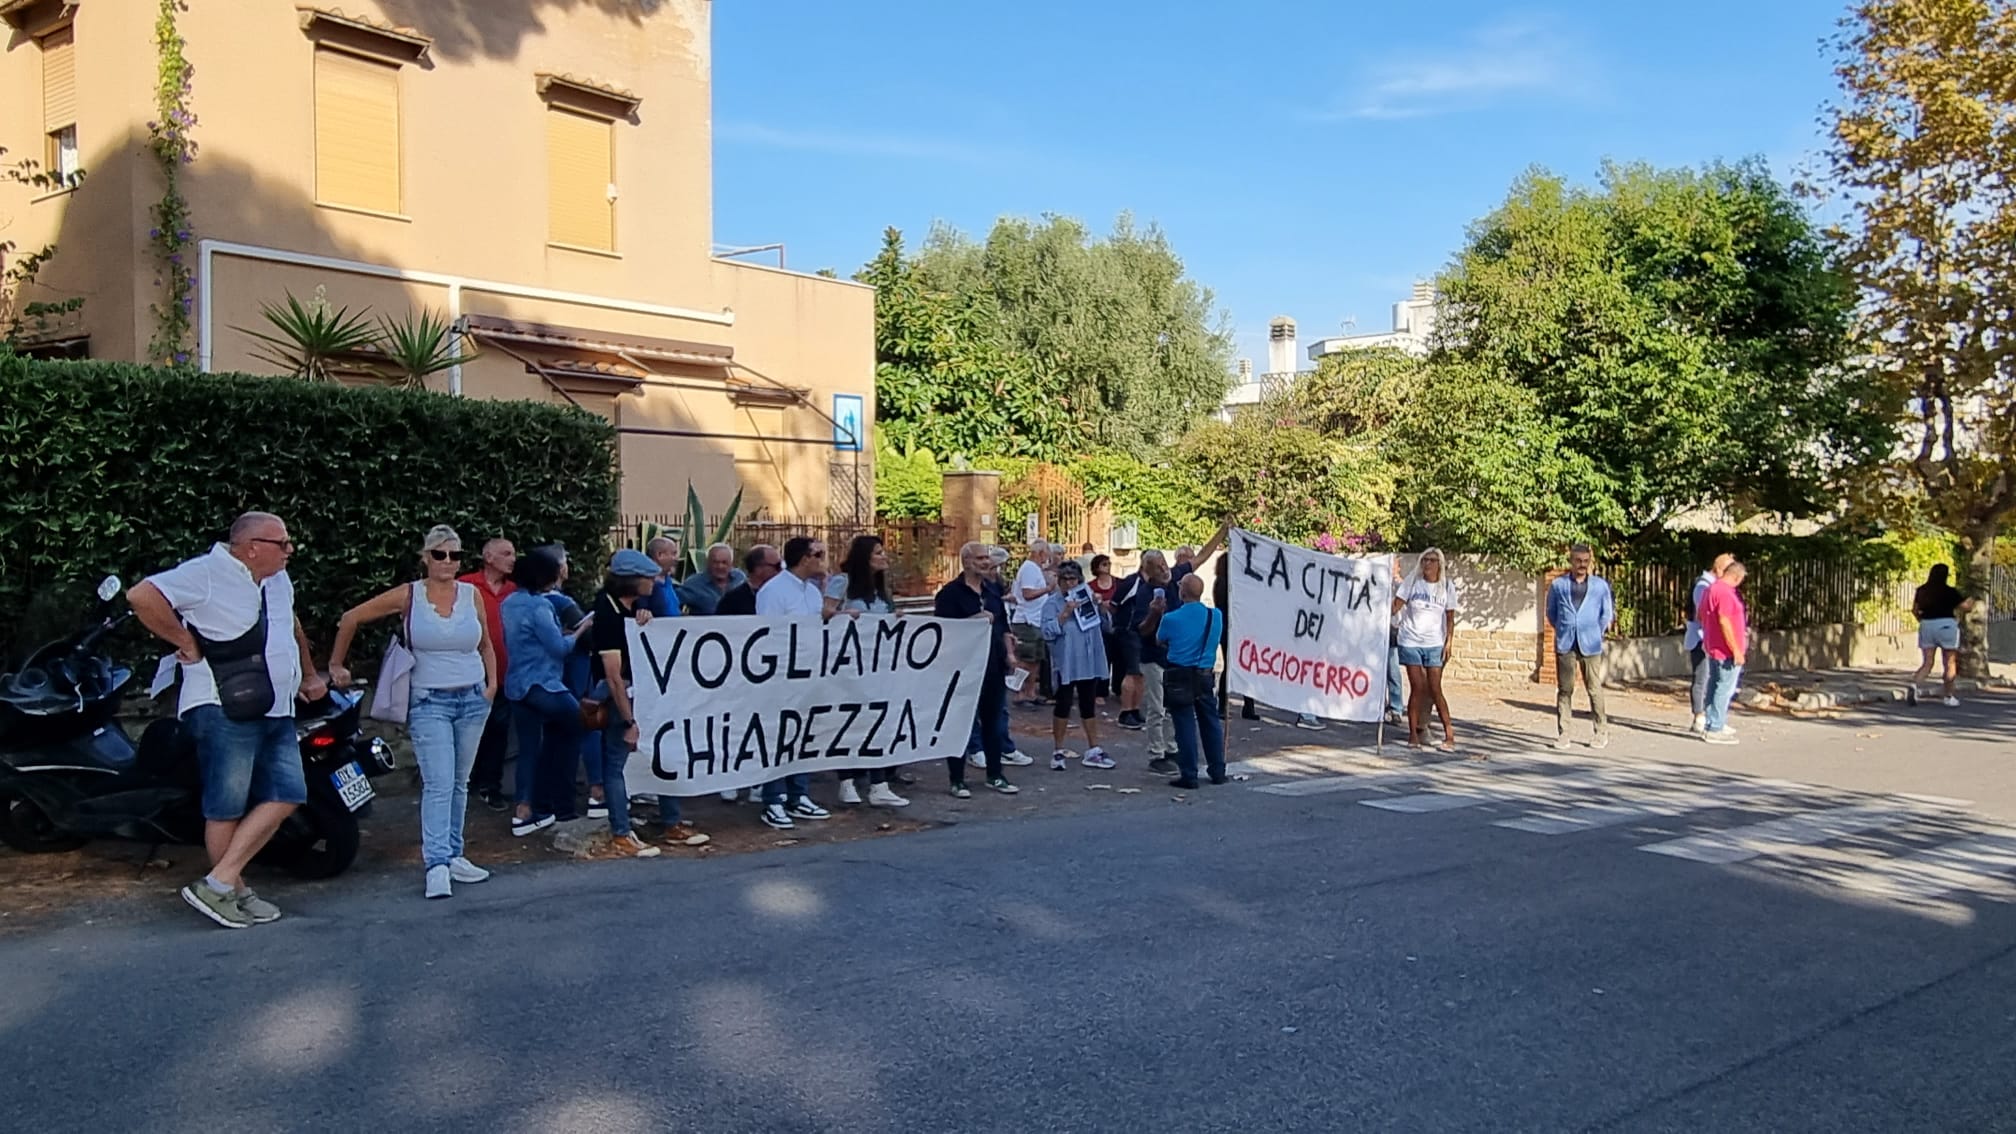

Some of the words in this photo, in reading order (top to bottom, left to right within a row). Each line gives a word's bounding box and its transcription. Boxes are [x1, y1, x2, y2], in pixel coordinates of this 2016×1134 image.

[1242, 537, 1290, 590] LA
[1294, 609, 1324, 641] DEI
[1238, 639, 1369, 699] CASCIOFERRO
